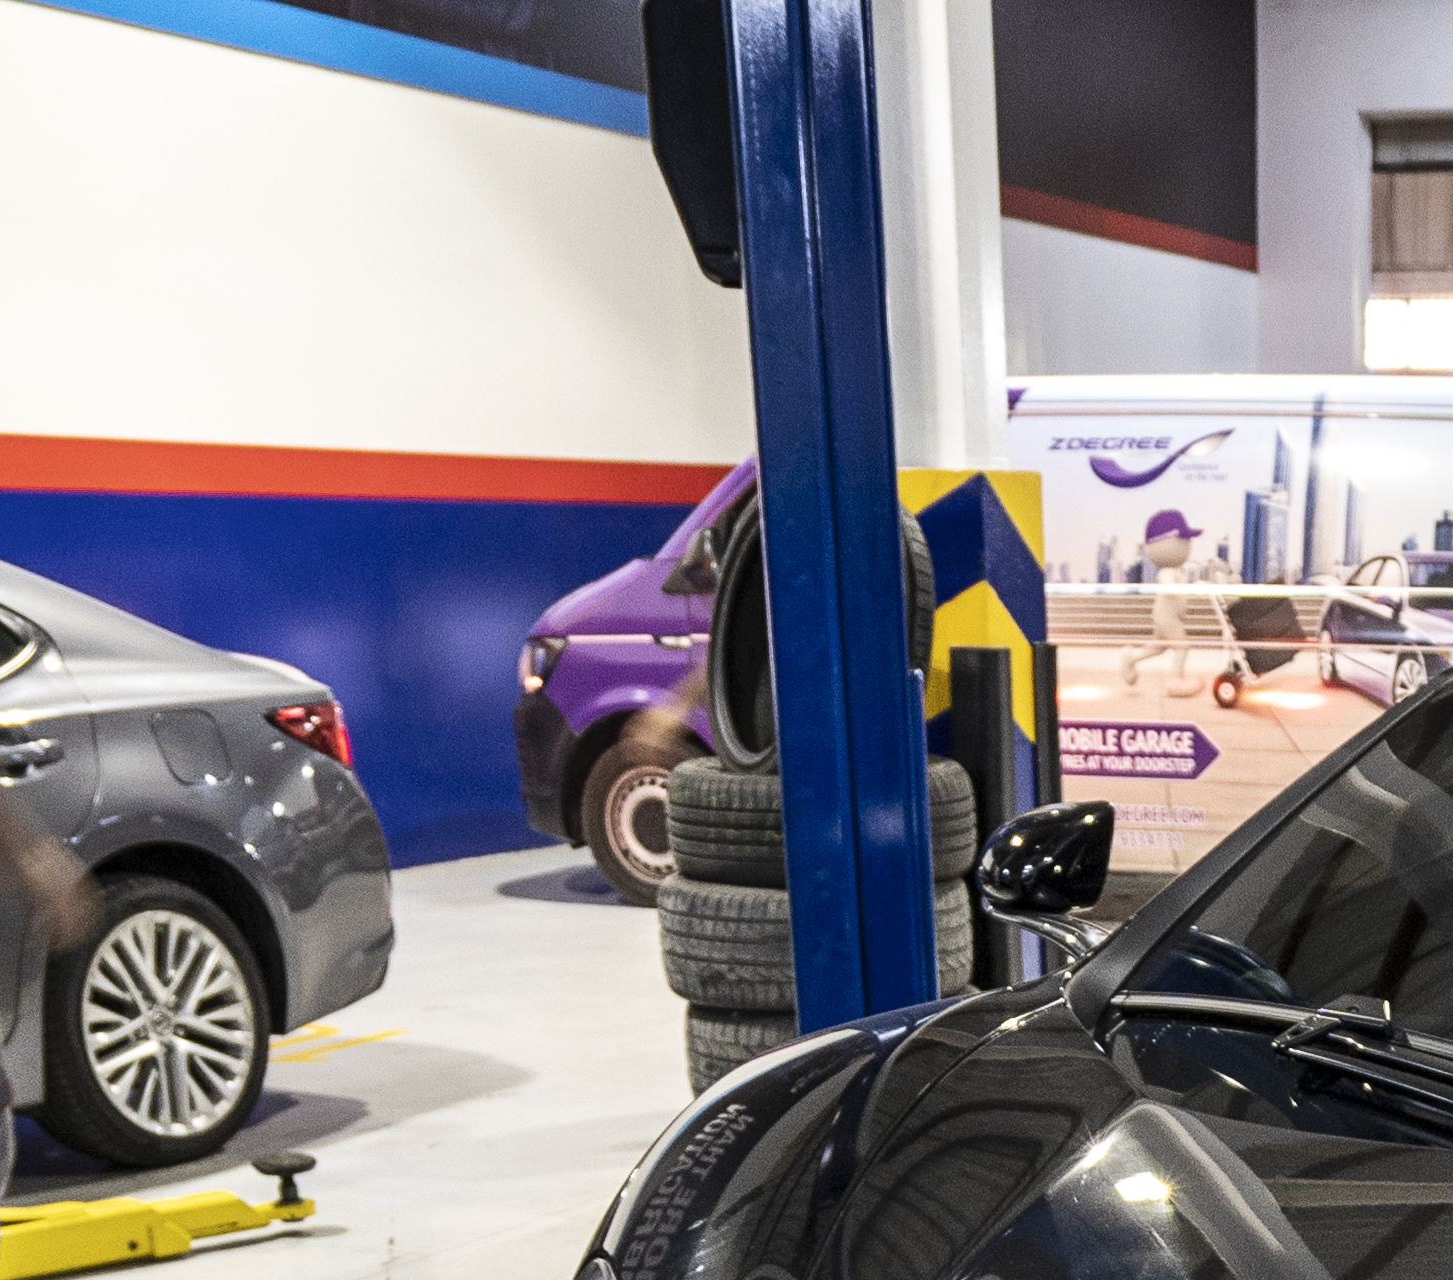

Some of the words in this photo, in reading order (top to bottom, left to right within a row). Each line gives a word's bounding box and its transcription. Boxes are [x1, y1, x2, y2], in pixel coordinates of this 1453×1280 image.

[1049, 436, 1174, 450] ZDEGREE
[1120, 729, 1195, 755] GARAGE
[1087, 755, 1101, 769] AT
[1102, 756, 1133, 770] YOUR
[1134, 757, 1196, 772] DOORSTEP
[1114, 806, 1204, 824] DEGREE.COM
